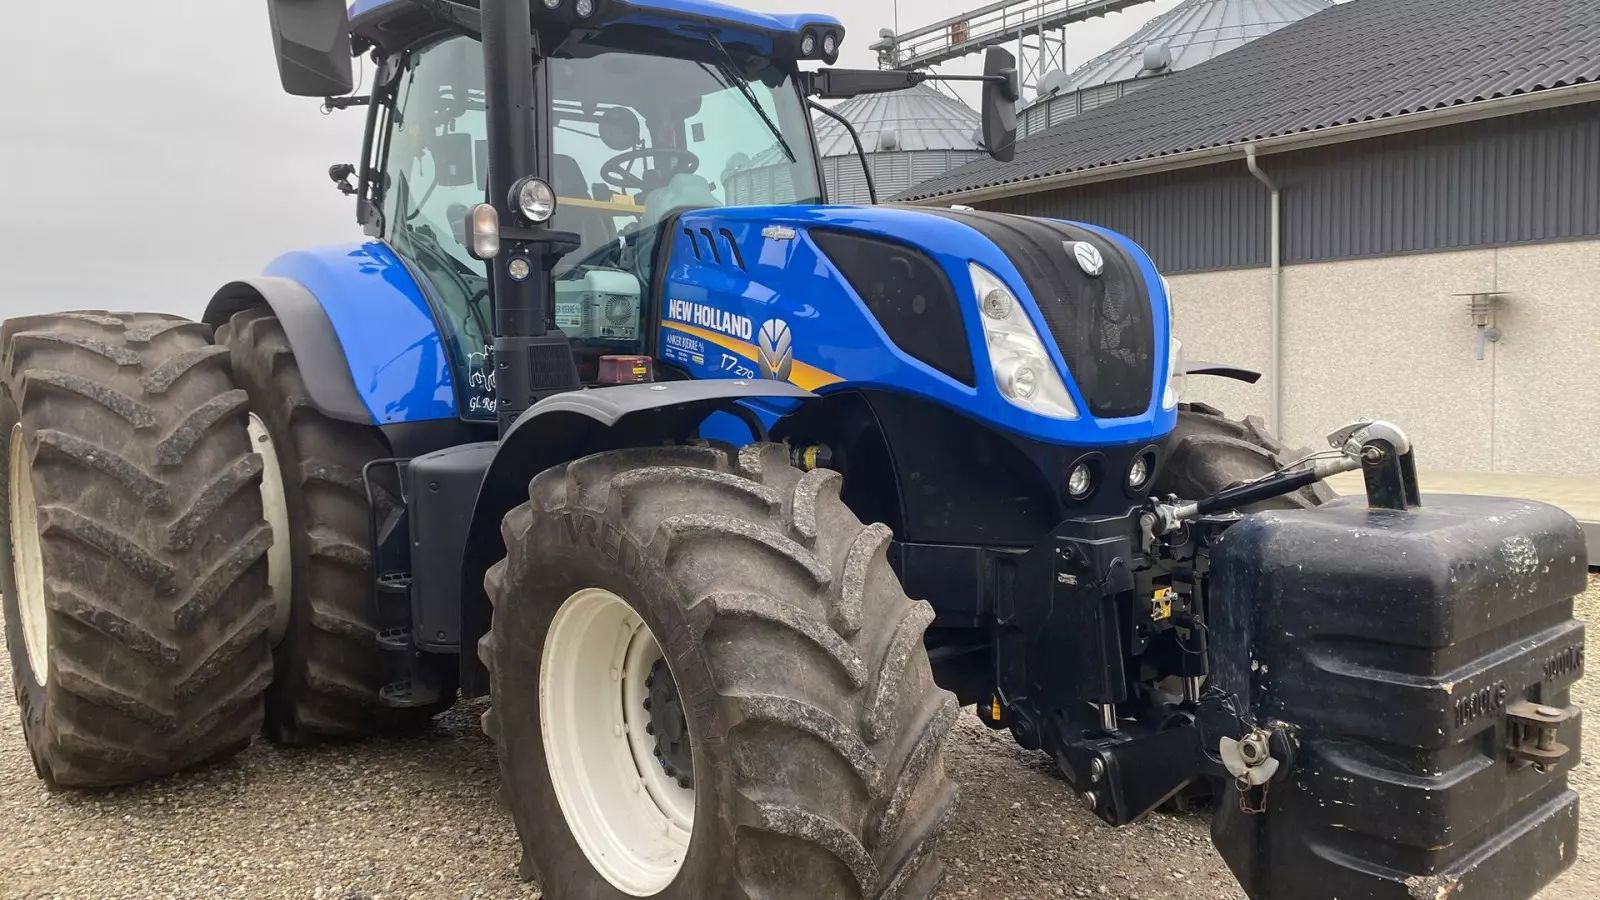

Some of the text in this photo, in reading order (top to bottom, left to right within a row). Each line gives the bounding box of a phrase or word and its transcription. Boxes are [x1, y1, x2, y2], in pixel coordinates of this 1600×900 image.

[669, 299, 752, 340] NEW HOLLAND
[720, 353, 754, 379] T7.270
